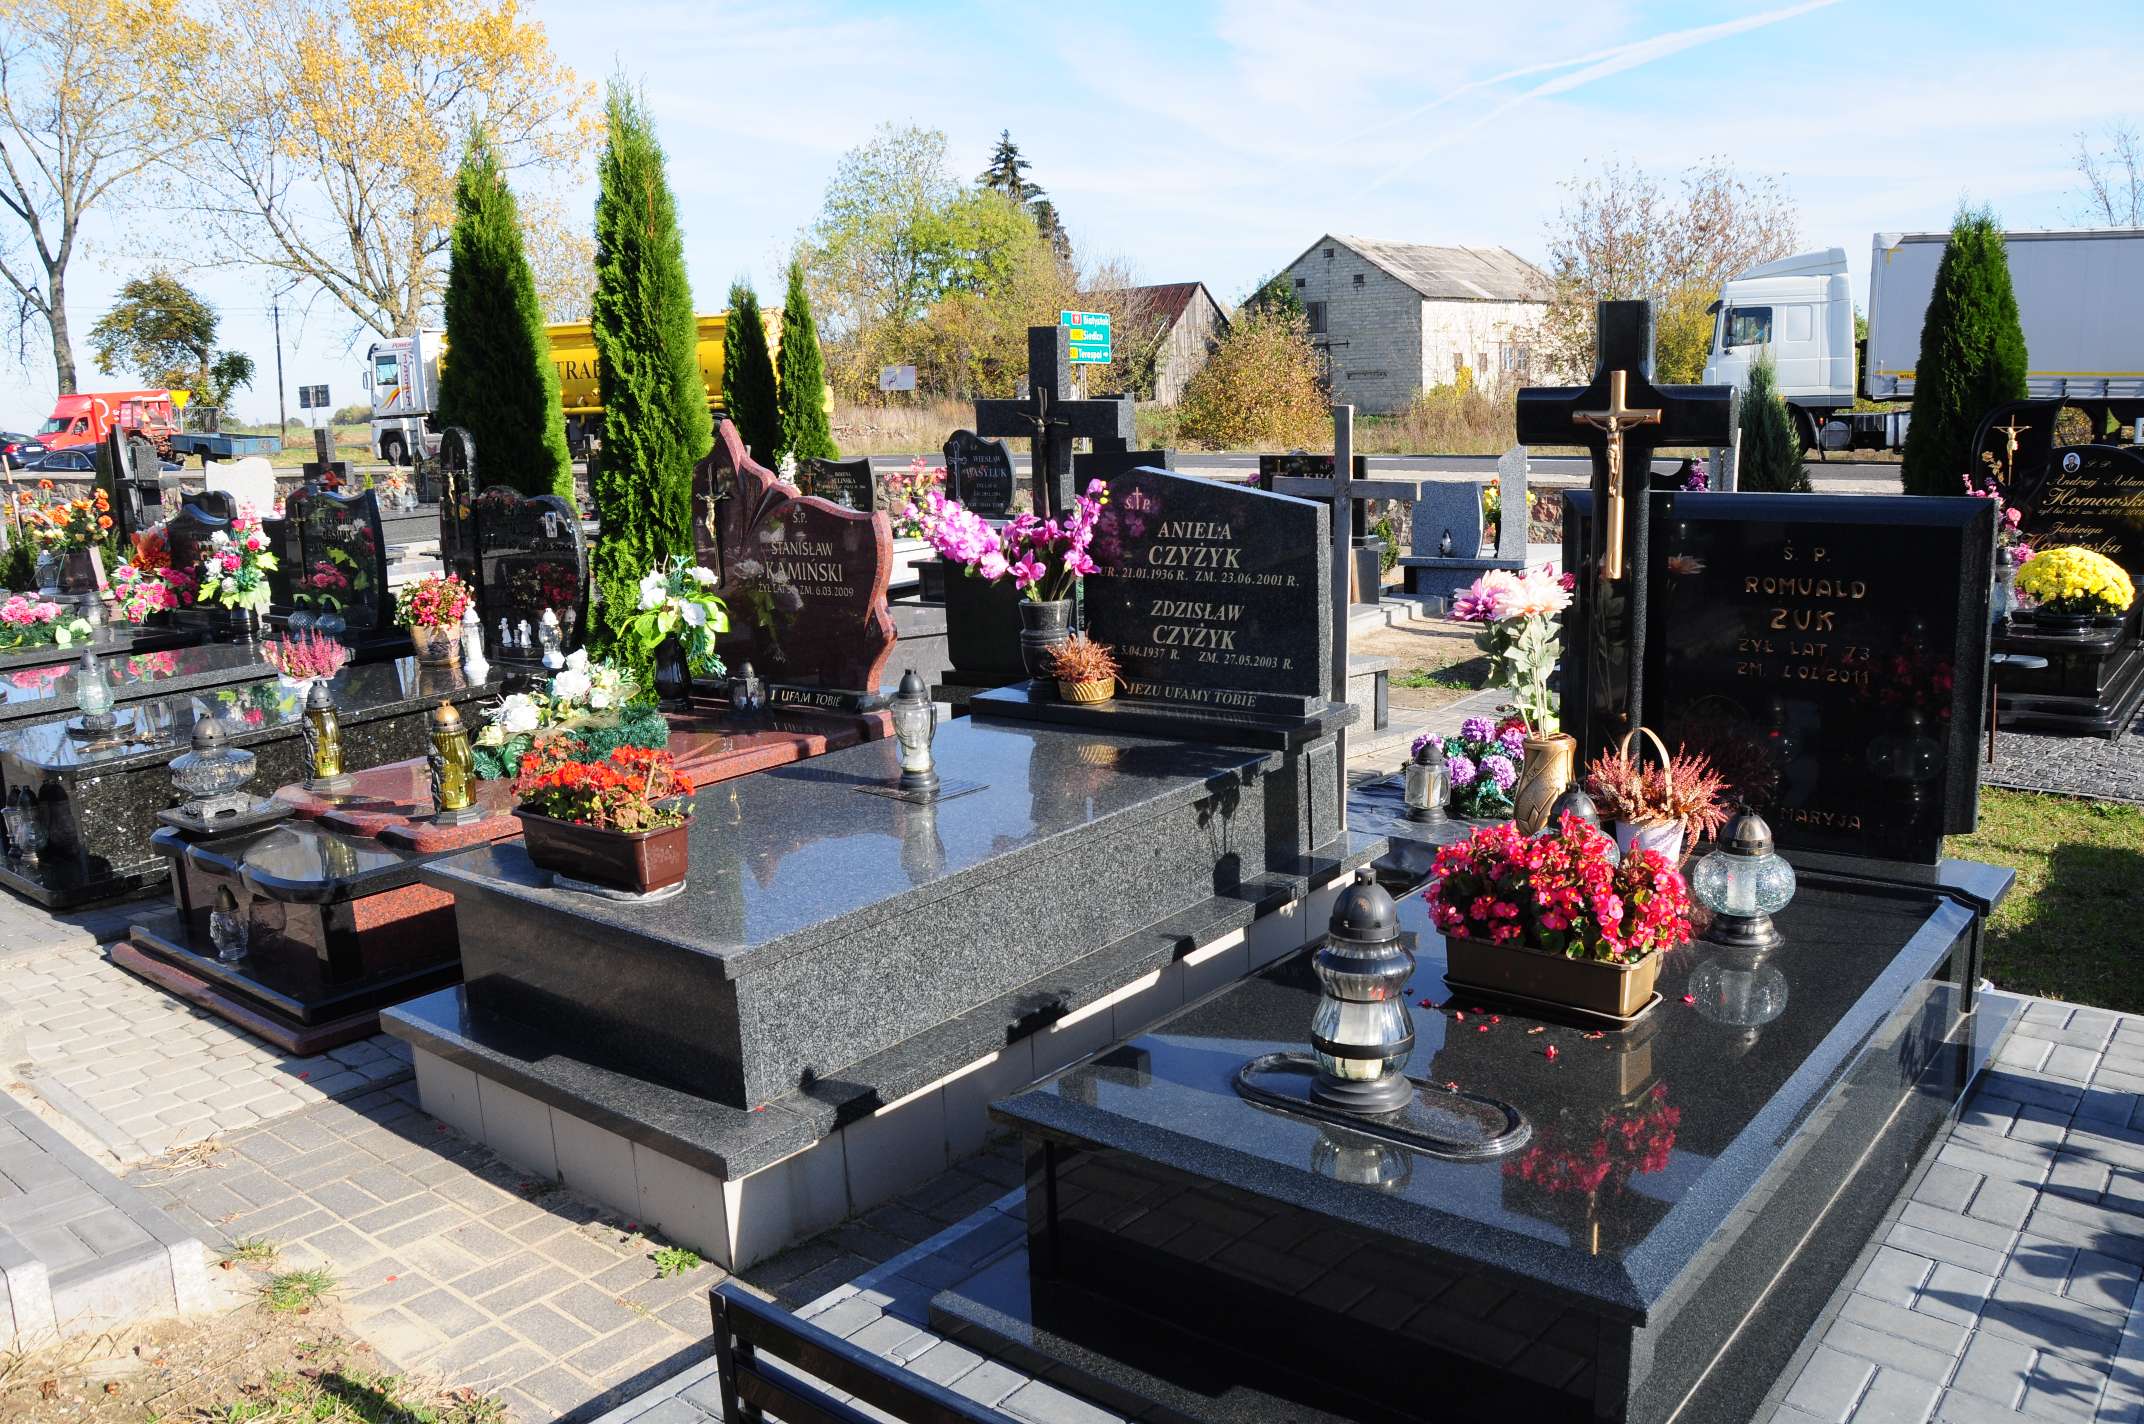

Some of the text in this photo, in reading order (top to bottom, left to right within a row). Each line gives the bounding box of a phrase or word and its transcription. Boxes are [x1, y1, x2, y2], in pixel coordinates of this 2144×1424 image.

[1148, 542, 1243, 569] CZYŻYK
[766, 558, 844, 582] KAMIŃSKI
[1176, 570, 1189, 582] R.
[1195, 571, 1218, 583] ZM.
[1221, 574, 1283, 586] 23.06.2001
[1286, 576, 1301, 587] R.
[1744, 576, 1866, 599] ROMUALD
[1150, 600, 1245, 622] ZDZISŁAW
[1152, 622, 1238, 650] CZYŻYK
[1170, 649, 1181, 660] R.
[1198, 652, 1219, 664] ZM.
[1223, 655, 1279, 669] 27.05.2003
[1282, 658, 1295, 670] R.
[1790, 641, 1829, 657] LAT
[781, 689, 811, 704] UFAM
[815, 693, 841, 707] TOBIE
[1127, 682, 1258, 708] JEZU UFAMY TOBIE
[1780, 807, 1861, 830] MARYJA
